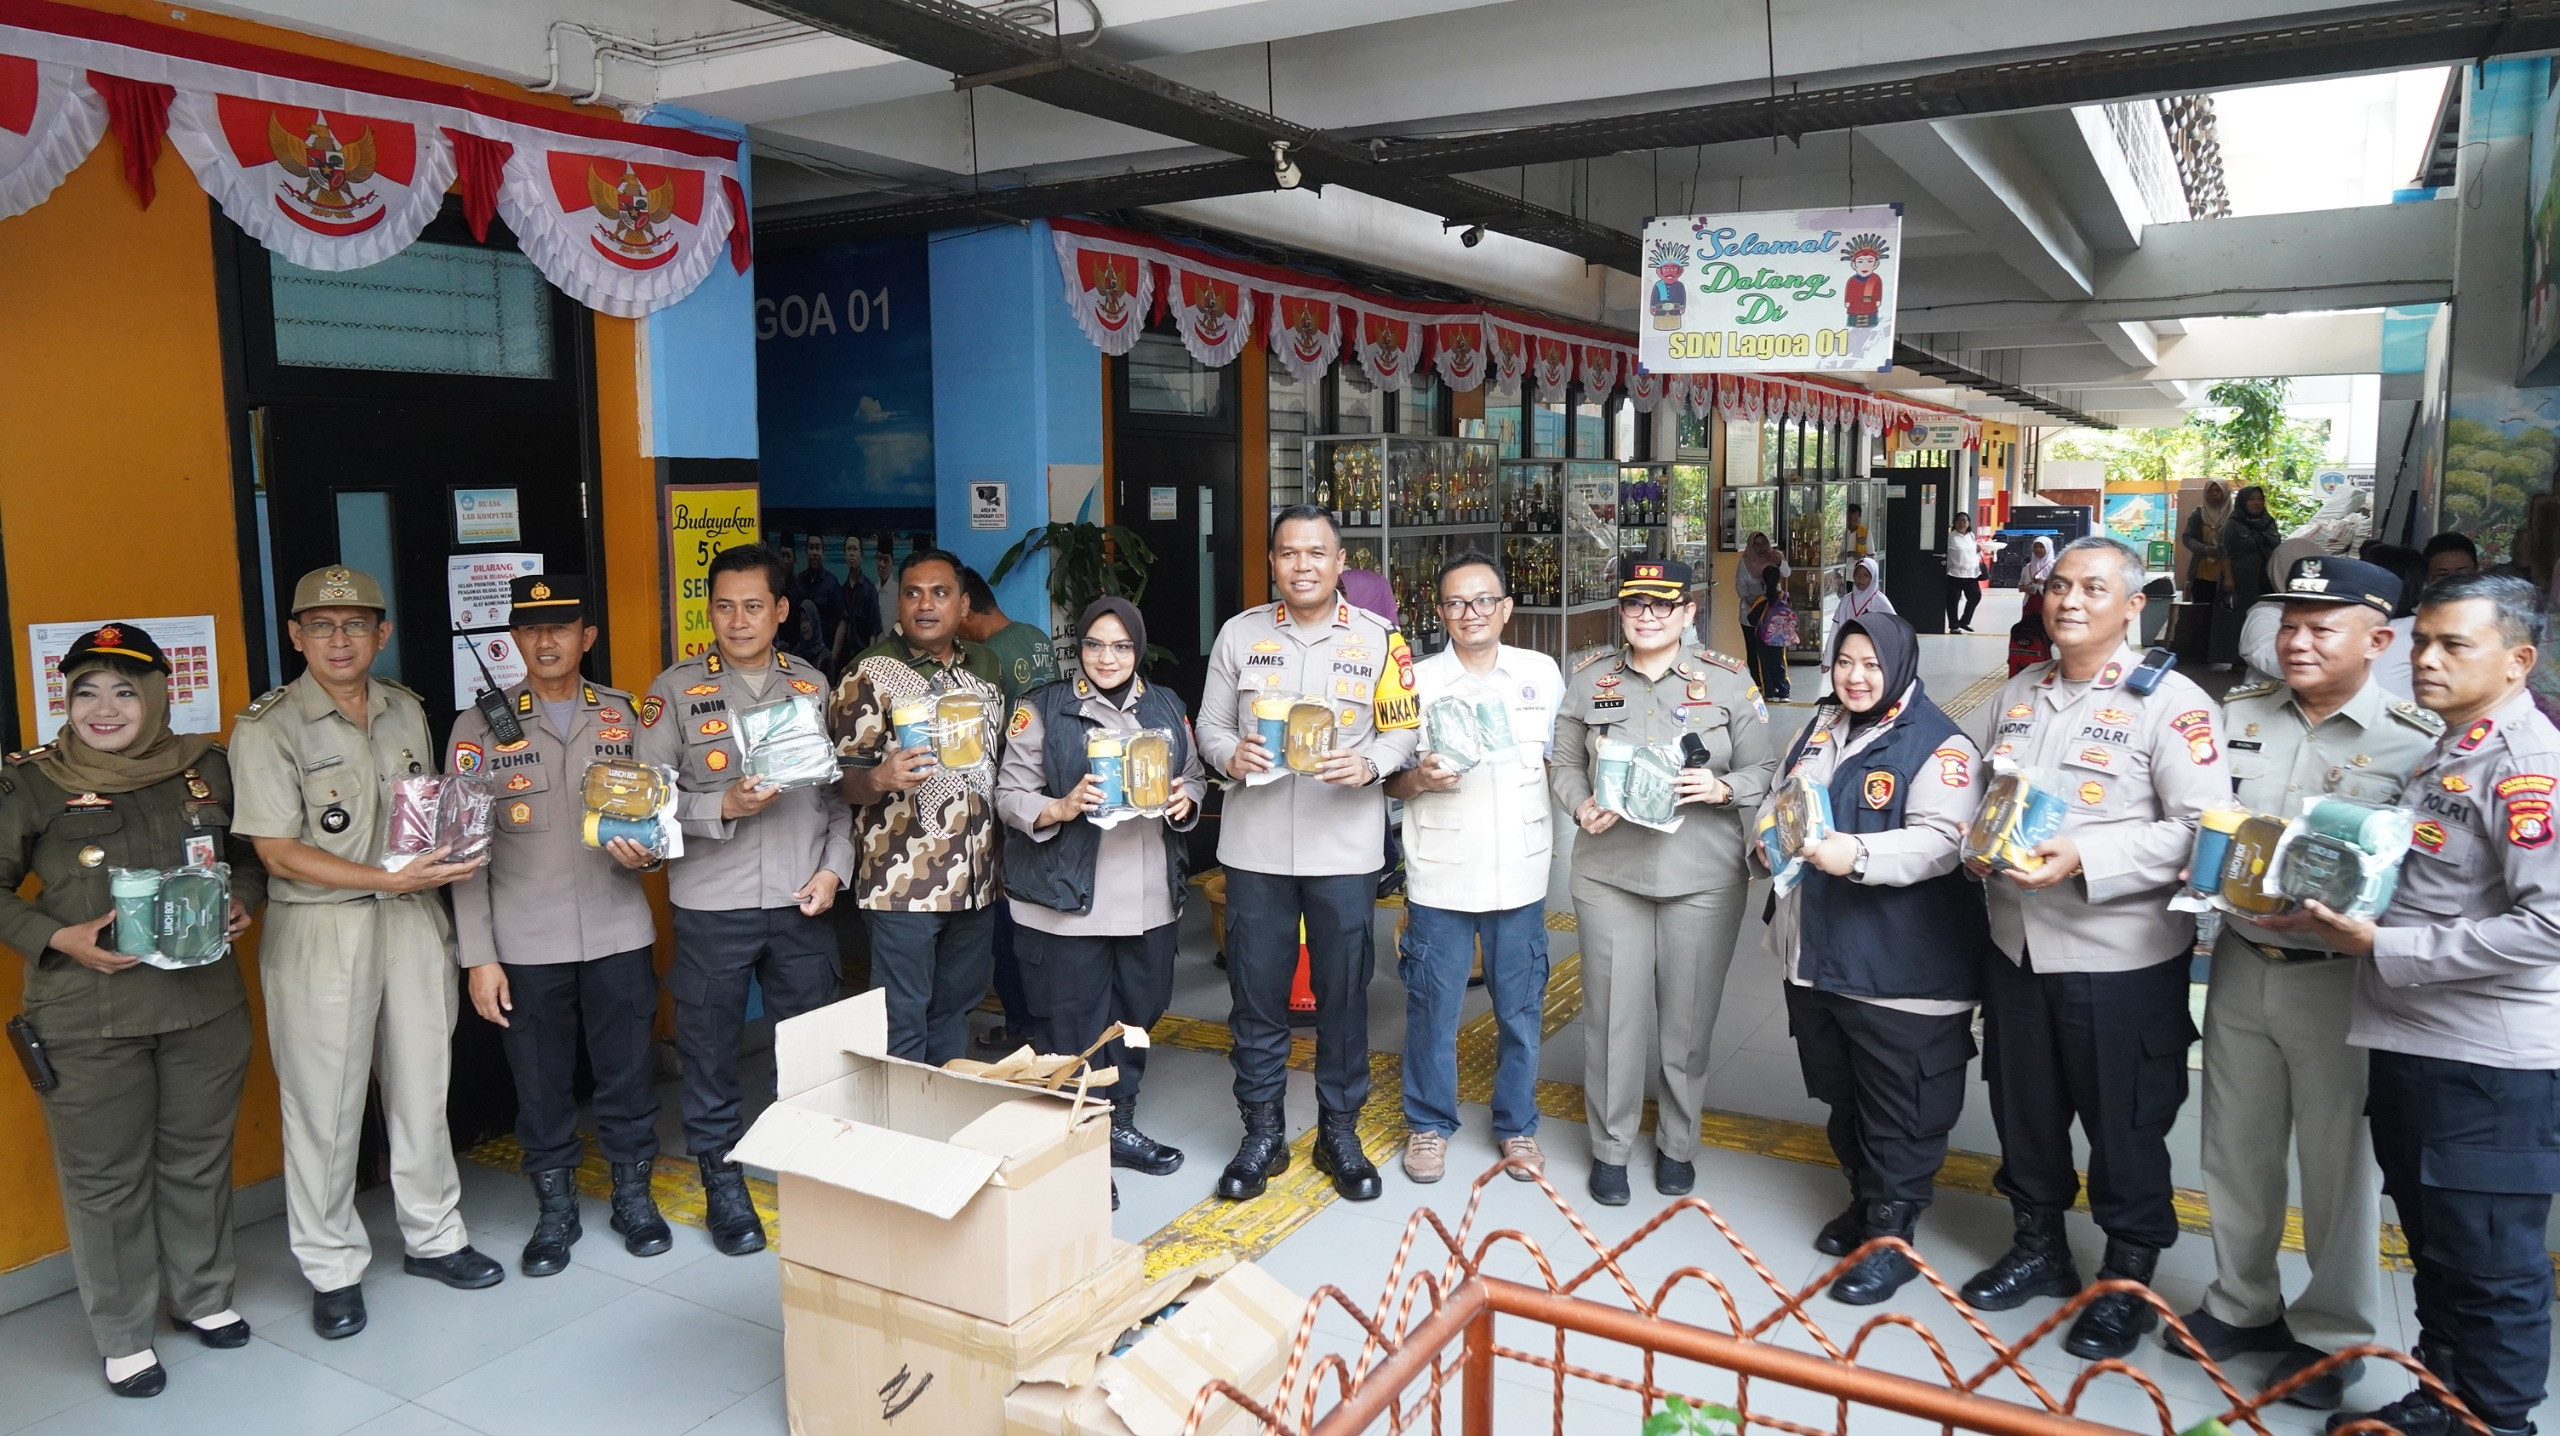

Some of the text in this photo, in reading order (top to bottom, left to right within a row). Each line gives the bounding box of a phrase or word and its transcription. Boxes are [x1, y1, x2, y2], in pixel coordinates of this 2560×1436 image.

[1696, 227, 1841, 260] Selamat
[1700, 261, 1836, 301] Datang
[848, 287, 889, 331] 01
[1735, 293, 1788, 324] Di
[1669, 329, 1849, 360] SDN Lagoa 01
[478, 500, 502, 508] RUANG
[673, 504, 757, 538] Budayakan
[474, 563, 513, 572] DILARANG
[685, 610, 710, 631] SA
[685, 642, 711, 656] SA
[1247, 656, 1284, 666] JAMES
[1333, 663, 1372, 677] POLRI
[690, 700, 726, 716] AMIN
[1377, 698, 1412, 725] WAKA
[1321, 727, 1331, 744] LUNCH
[2081, 726, 2129, 744] POLRI
[595, 744, 632, 756] POLR
[491, 752, 540, 770] ZUHRI
[608, 769, 637, 779] LUNCH BOX
[2228, 843, 2247, 879] LUNCH BOX
[164, 901, 174, 936] LUNCH BOX
